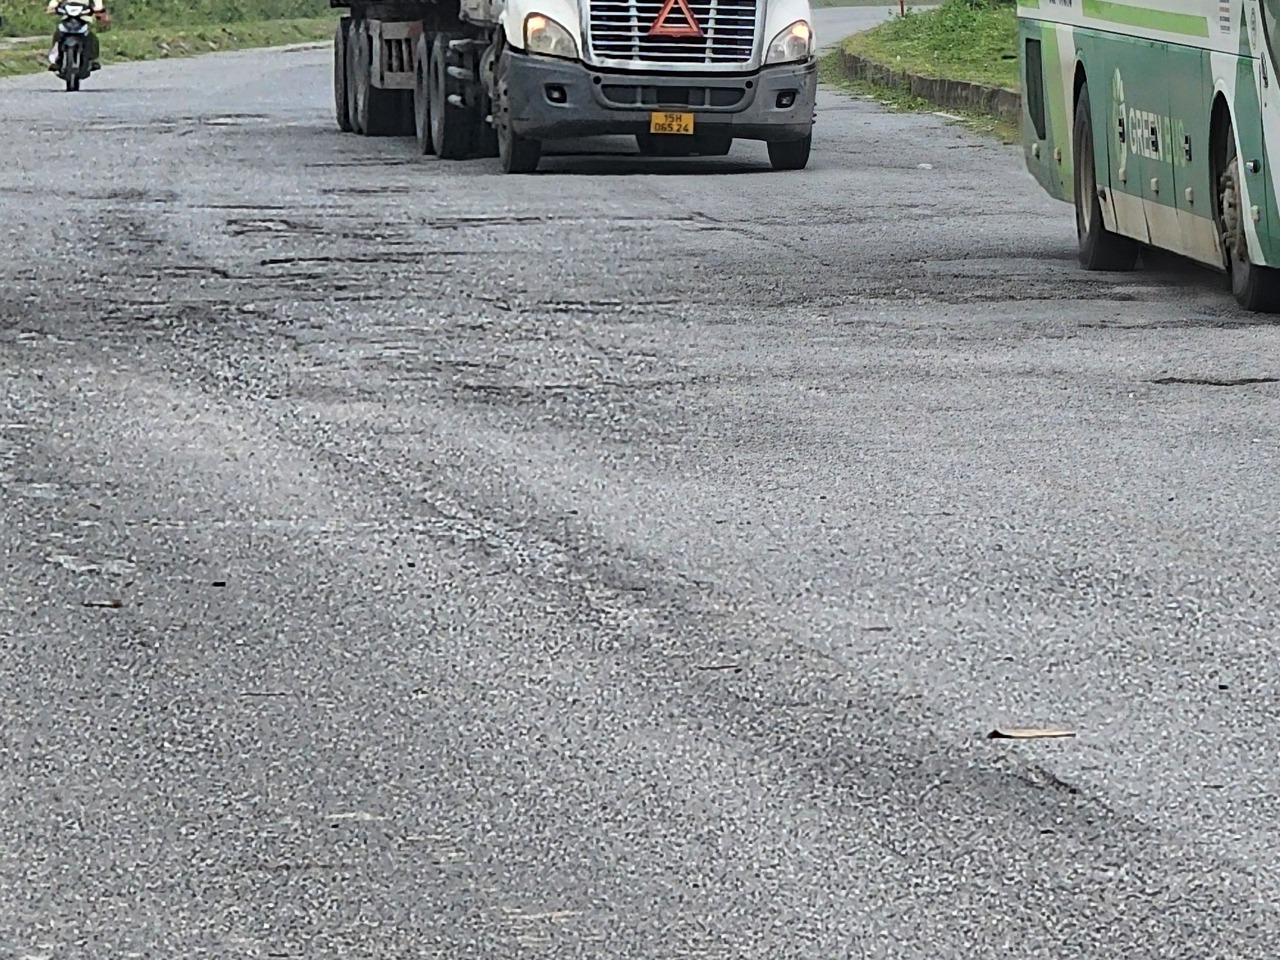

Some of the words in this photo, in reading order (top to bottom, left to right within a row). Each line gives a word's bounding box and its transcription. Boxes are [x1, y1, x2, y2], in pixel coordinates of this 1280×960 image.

[664, 113, 682, 123] 15H
[655, 122, 689, 132] 06524
[1129, 107, 1163, 162] GREEN
